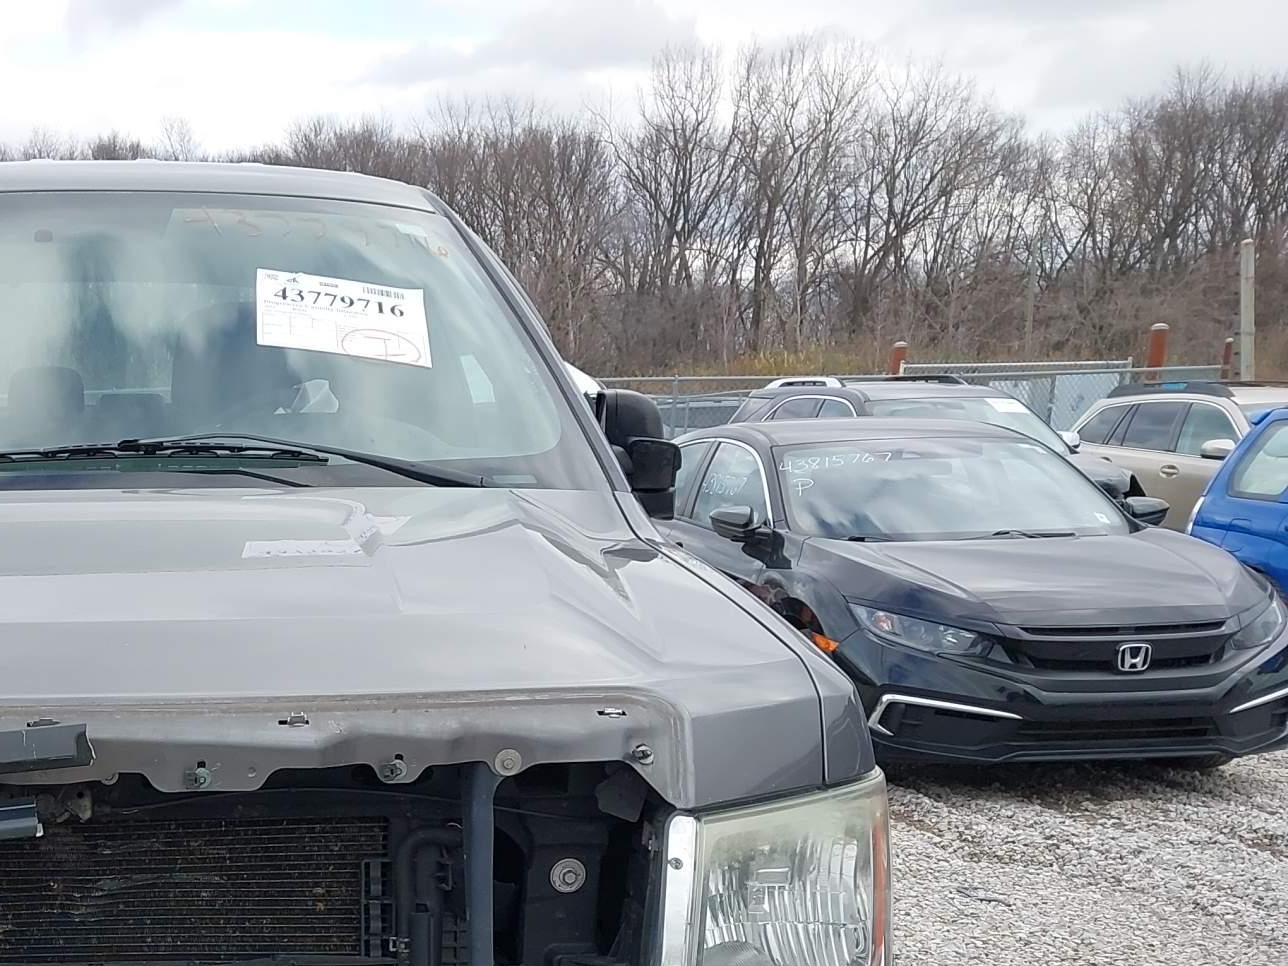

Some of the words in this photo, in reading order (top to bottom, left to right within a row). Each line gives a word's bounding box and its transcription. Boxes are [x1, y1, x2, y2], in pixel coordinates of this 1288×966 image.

[273, 286, 406, 318] 43779716
[779, 452, 892, 473] 43815767
[793, 478, 815, 497] P
